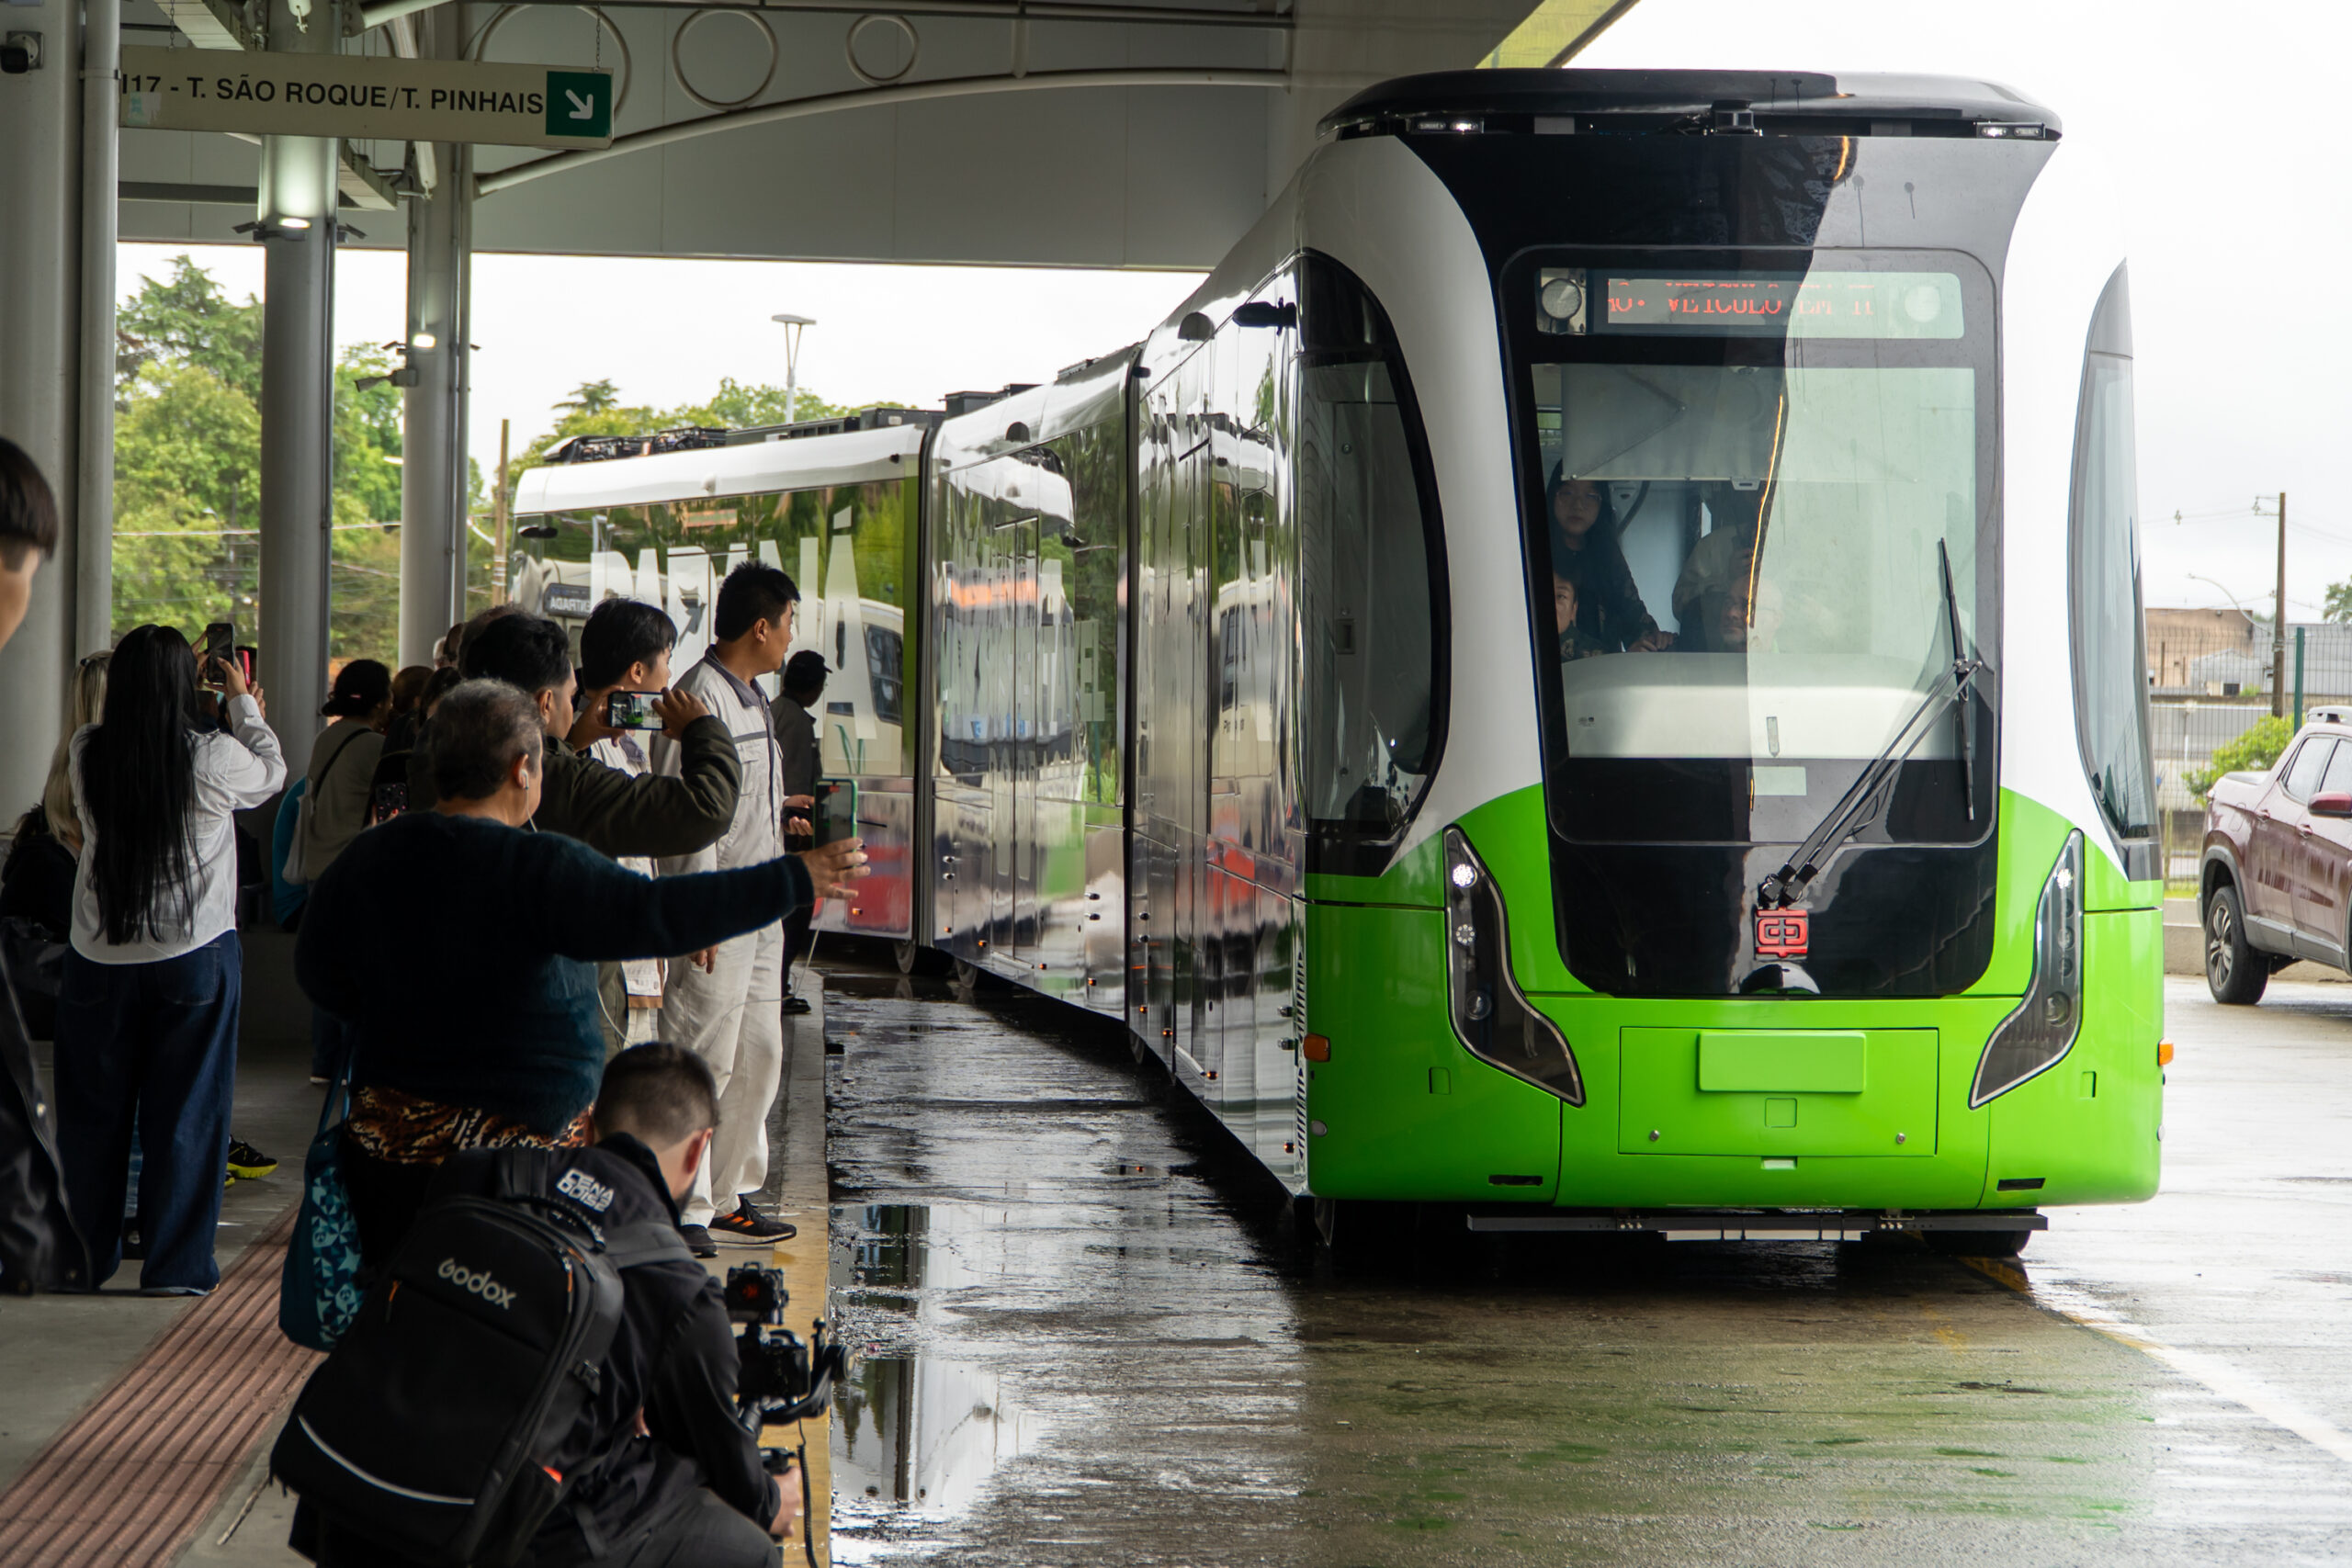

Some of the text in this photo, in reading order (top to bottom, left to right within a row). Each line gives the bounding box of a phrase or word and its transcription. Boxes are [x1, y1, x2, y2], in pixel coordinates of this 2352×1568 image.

[187, 76, 206, 98] T.
[216, 73, 275, 103] SÃO
[431, 88, 544, 115] PINHAIS
[437, 1258, 516, 1310] Godox
